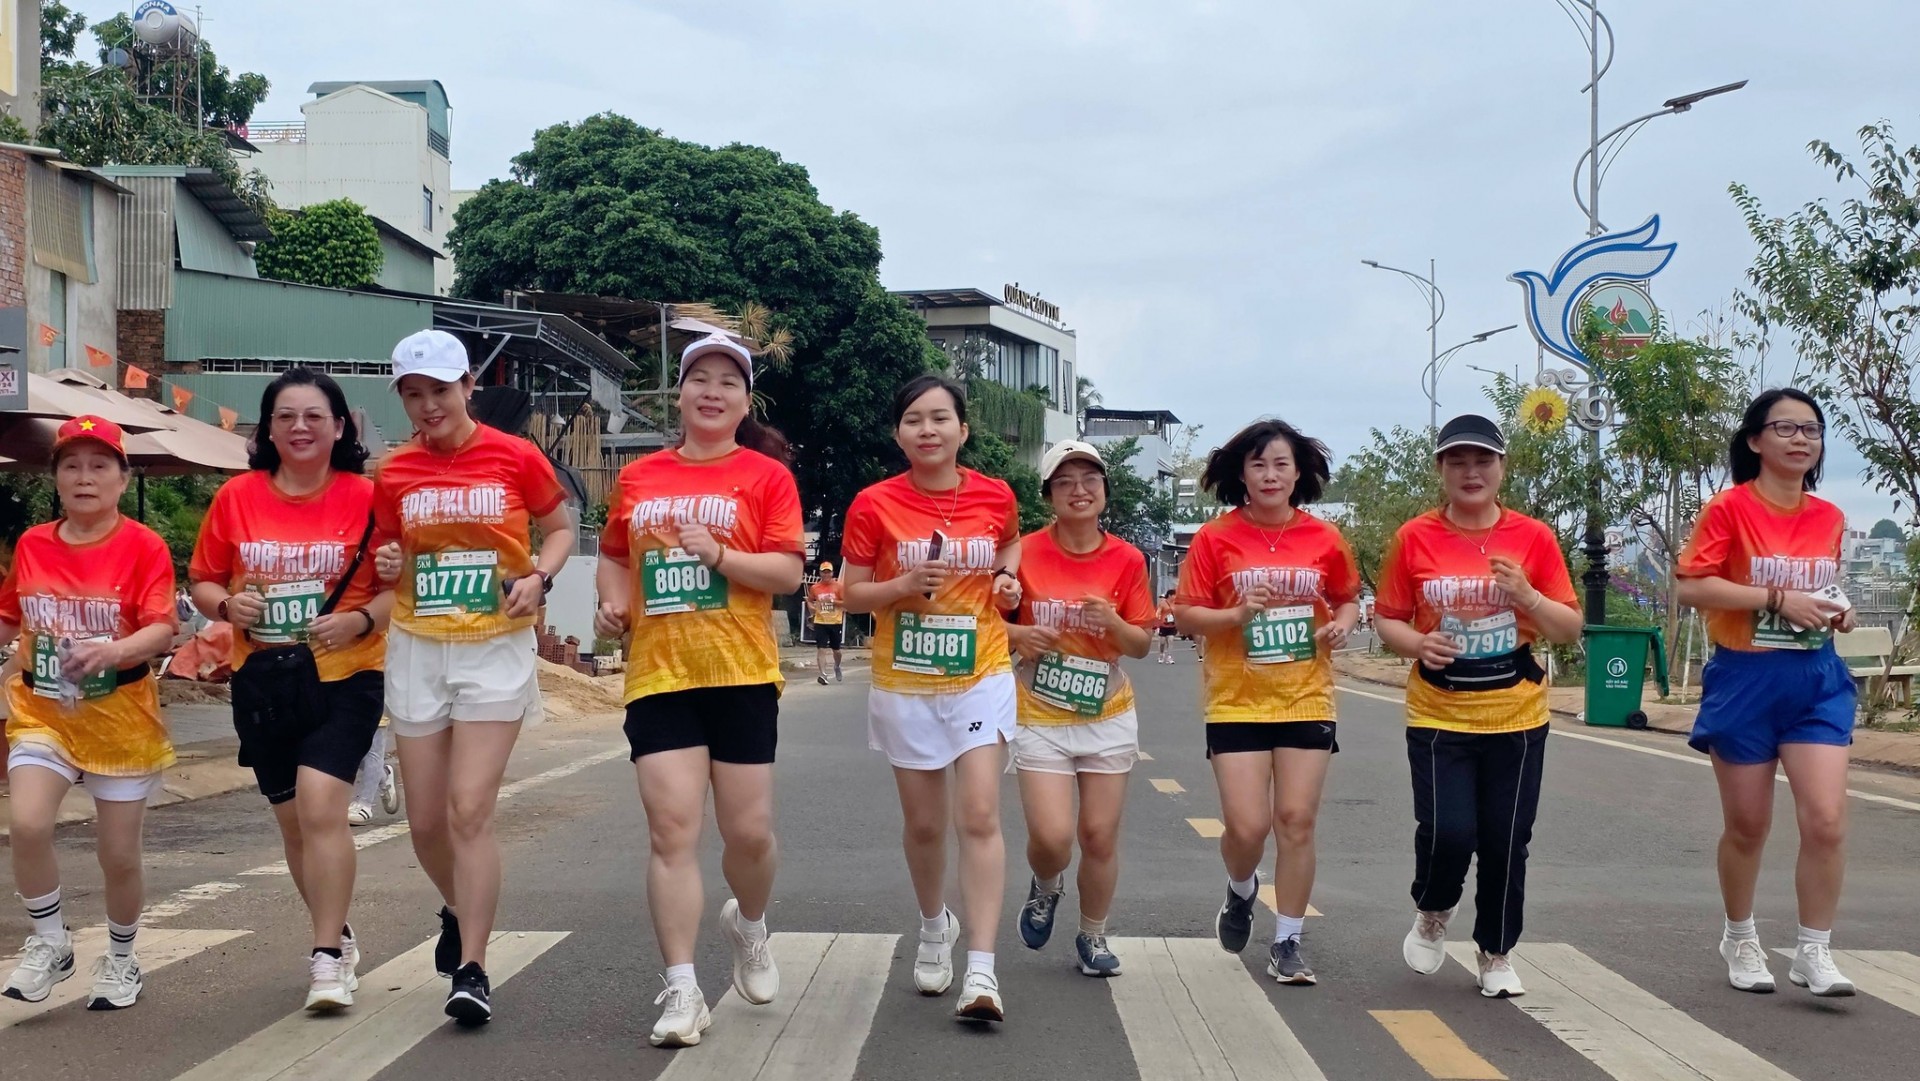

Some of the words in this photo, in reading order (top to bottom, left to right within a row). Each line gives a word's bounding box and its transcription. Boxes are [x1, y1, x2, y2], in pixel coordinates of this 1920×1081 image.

[416, 569, 492, 597] 817777
[655, 565, 710, 594] 8080
[254, 598, 319, 625] 1084
[902, 630, 968, 657] 818181
[1252, 622, 1308, 647] 51102
[1450, 627, 1517, 655] 97979
[1036, 664, 1106, 699] 568686
